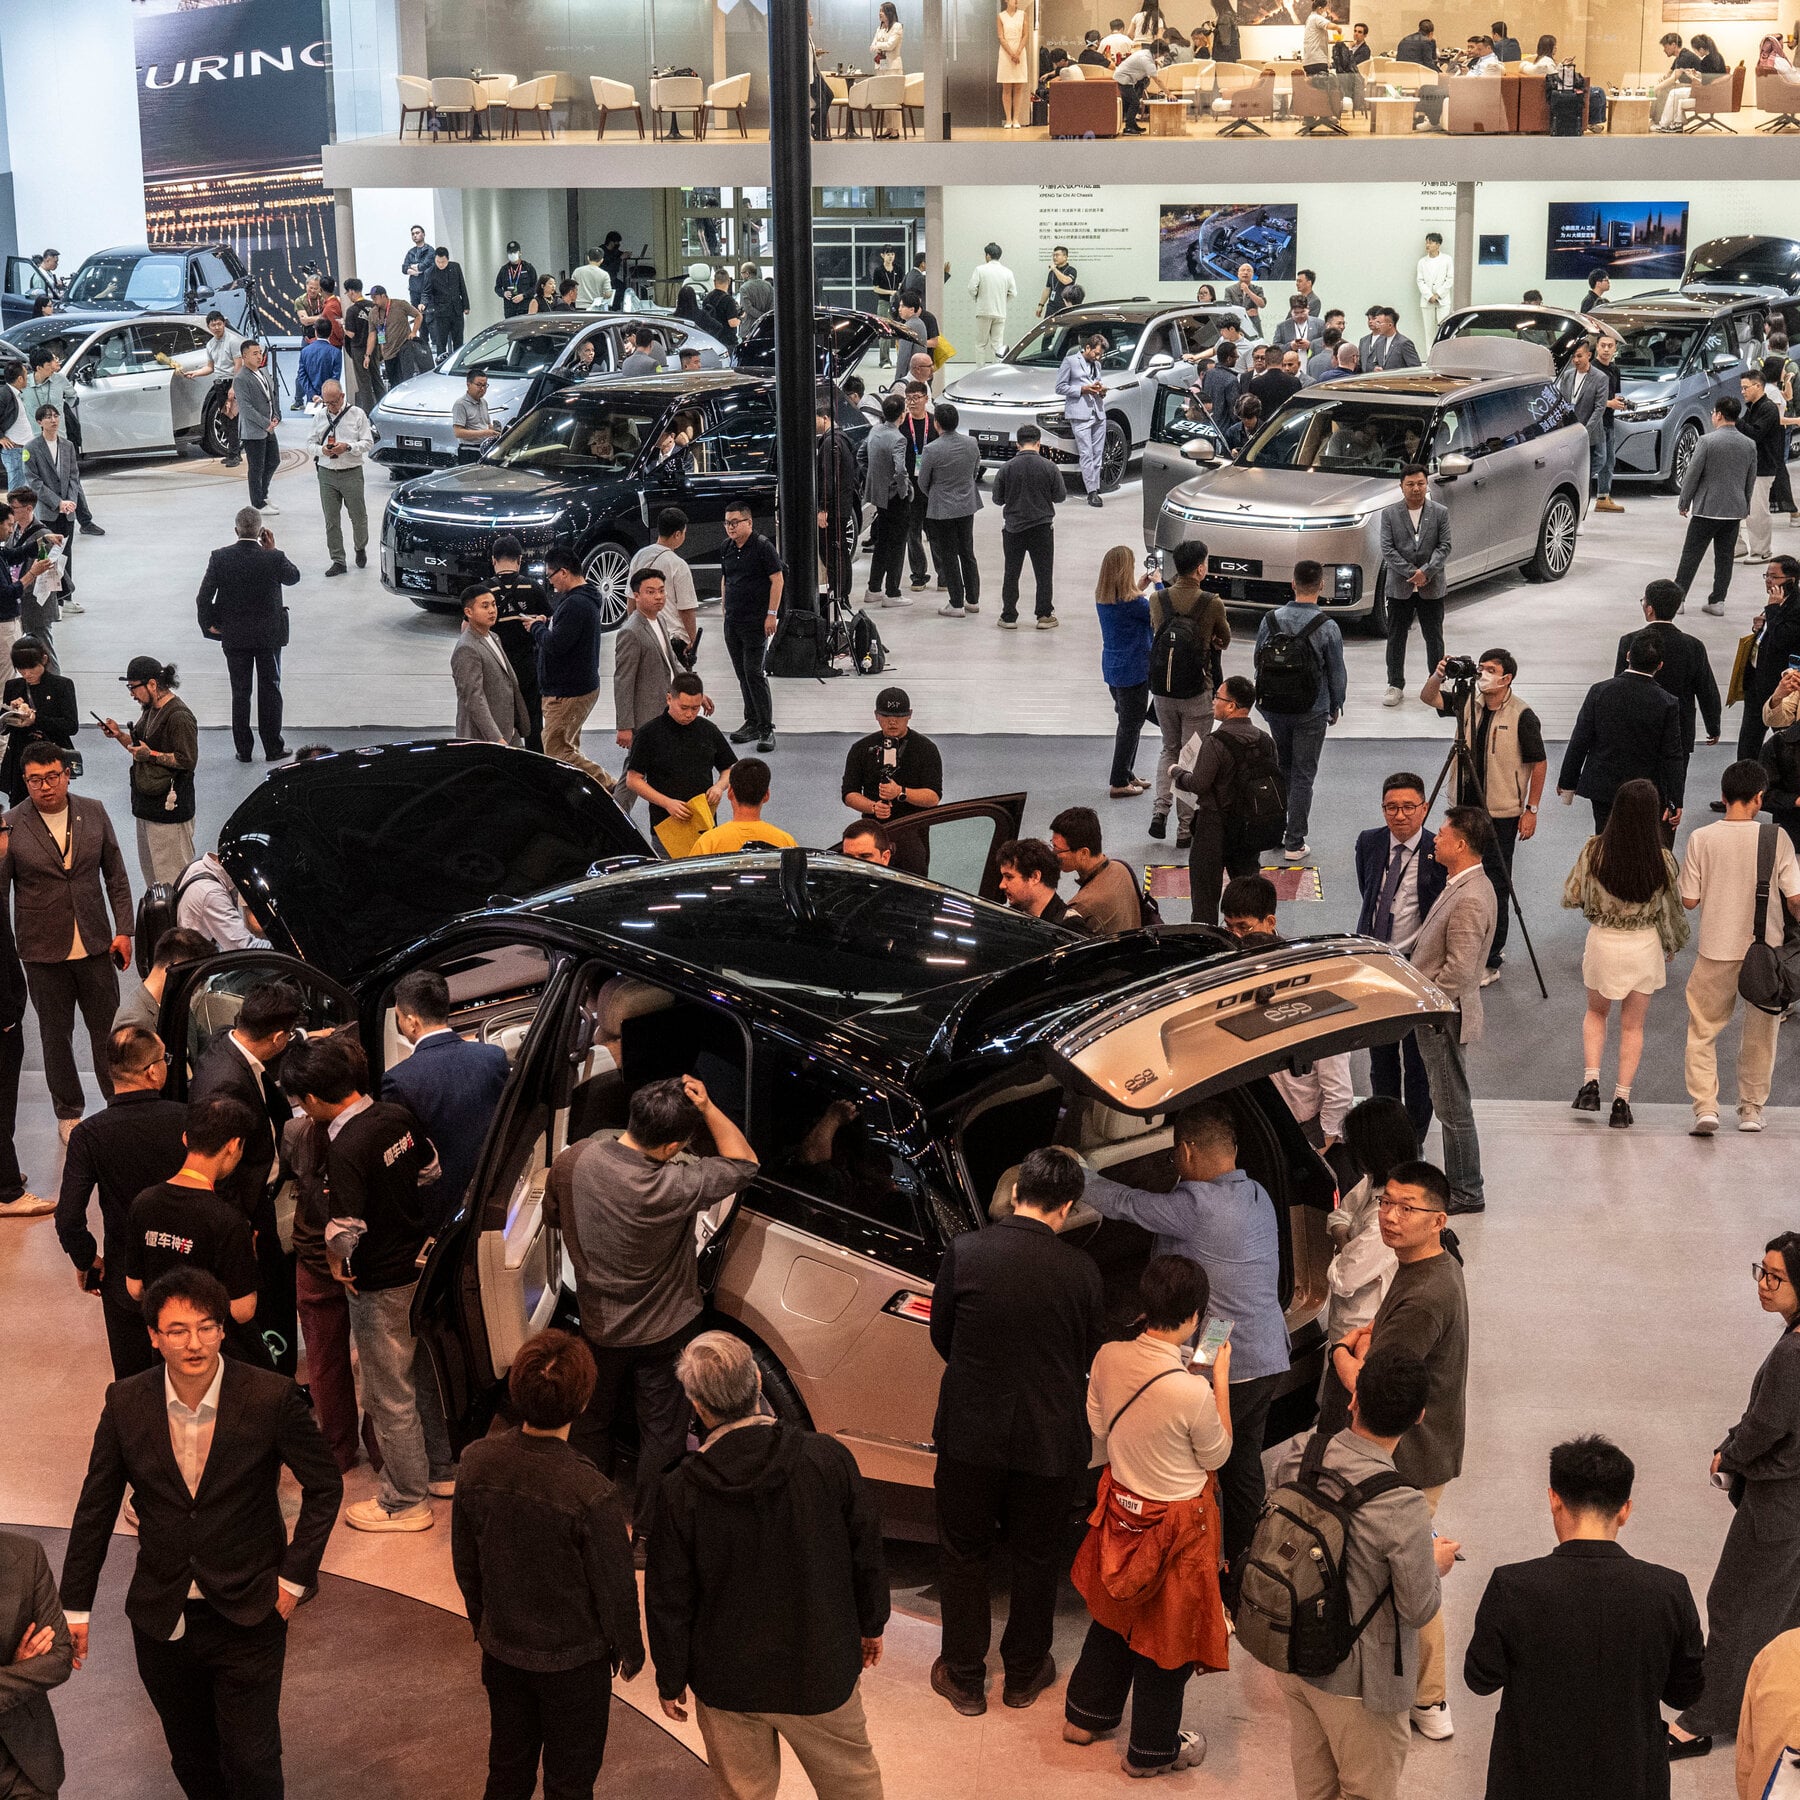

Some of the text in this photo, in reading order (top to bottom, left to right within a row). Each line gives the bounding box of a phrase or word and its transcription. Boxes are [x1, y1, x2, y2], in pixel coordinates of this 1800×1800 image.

[136, 40, 333, 89] URING
[424, 556, 448, 567] GX
[1220, 561, 1249, 572] GX
